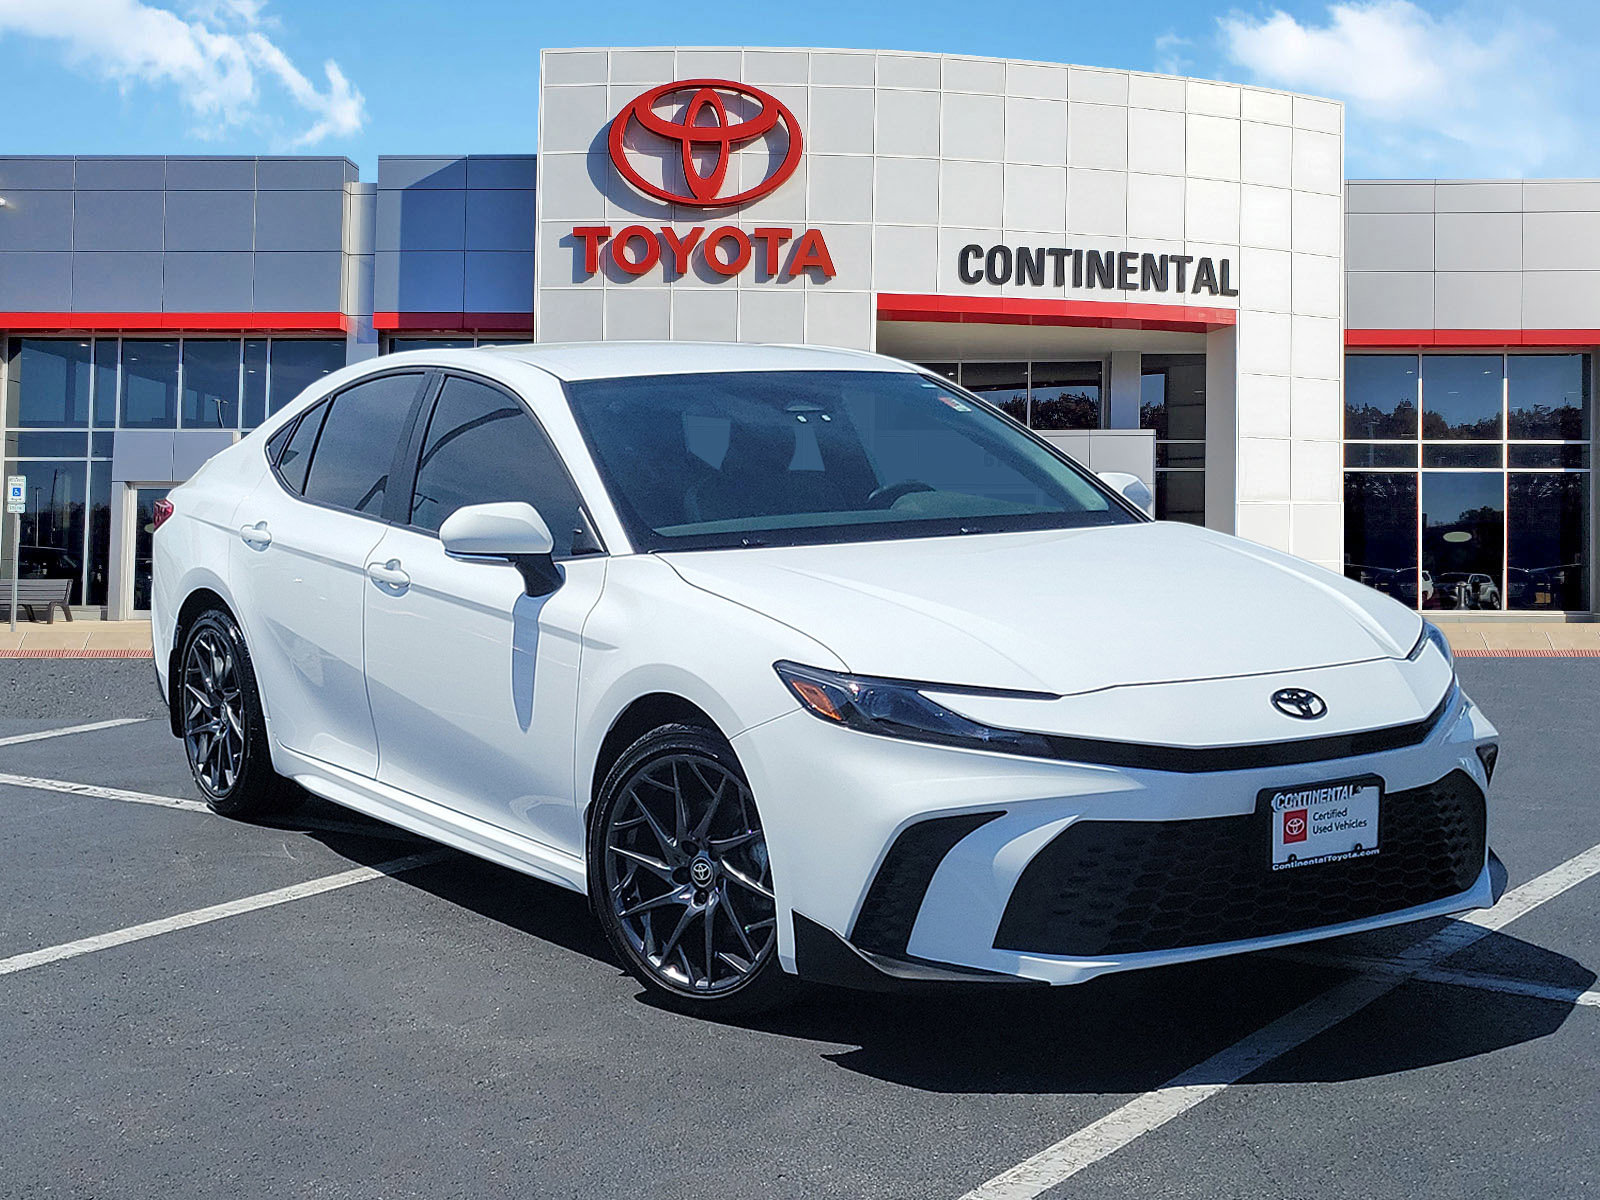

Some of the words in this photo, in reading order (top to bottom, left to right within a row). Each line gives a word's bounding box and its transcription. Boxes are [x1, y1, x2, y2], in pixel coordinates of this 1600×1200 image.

[573, 225, 837, 276] TOYOTA
[958, 244, 1239, 296] CONTINENTAL
[1271, 785, 1357, 812] CONTINENTAL
[1312, 807, 1348, 821] Certified
[1312, 824, 1333, 834] Used
[1335, 819, 1368, 832] Vehicles
[1272, 848, 1380, 871] ContinentalToyota.com
